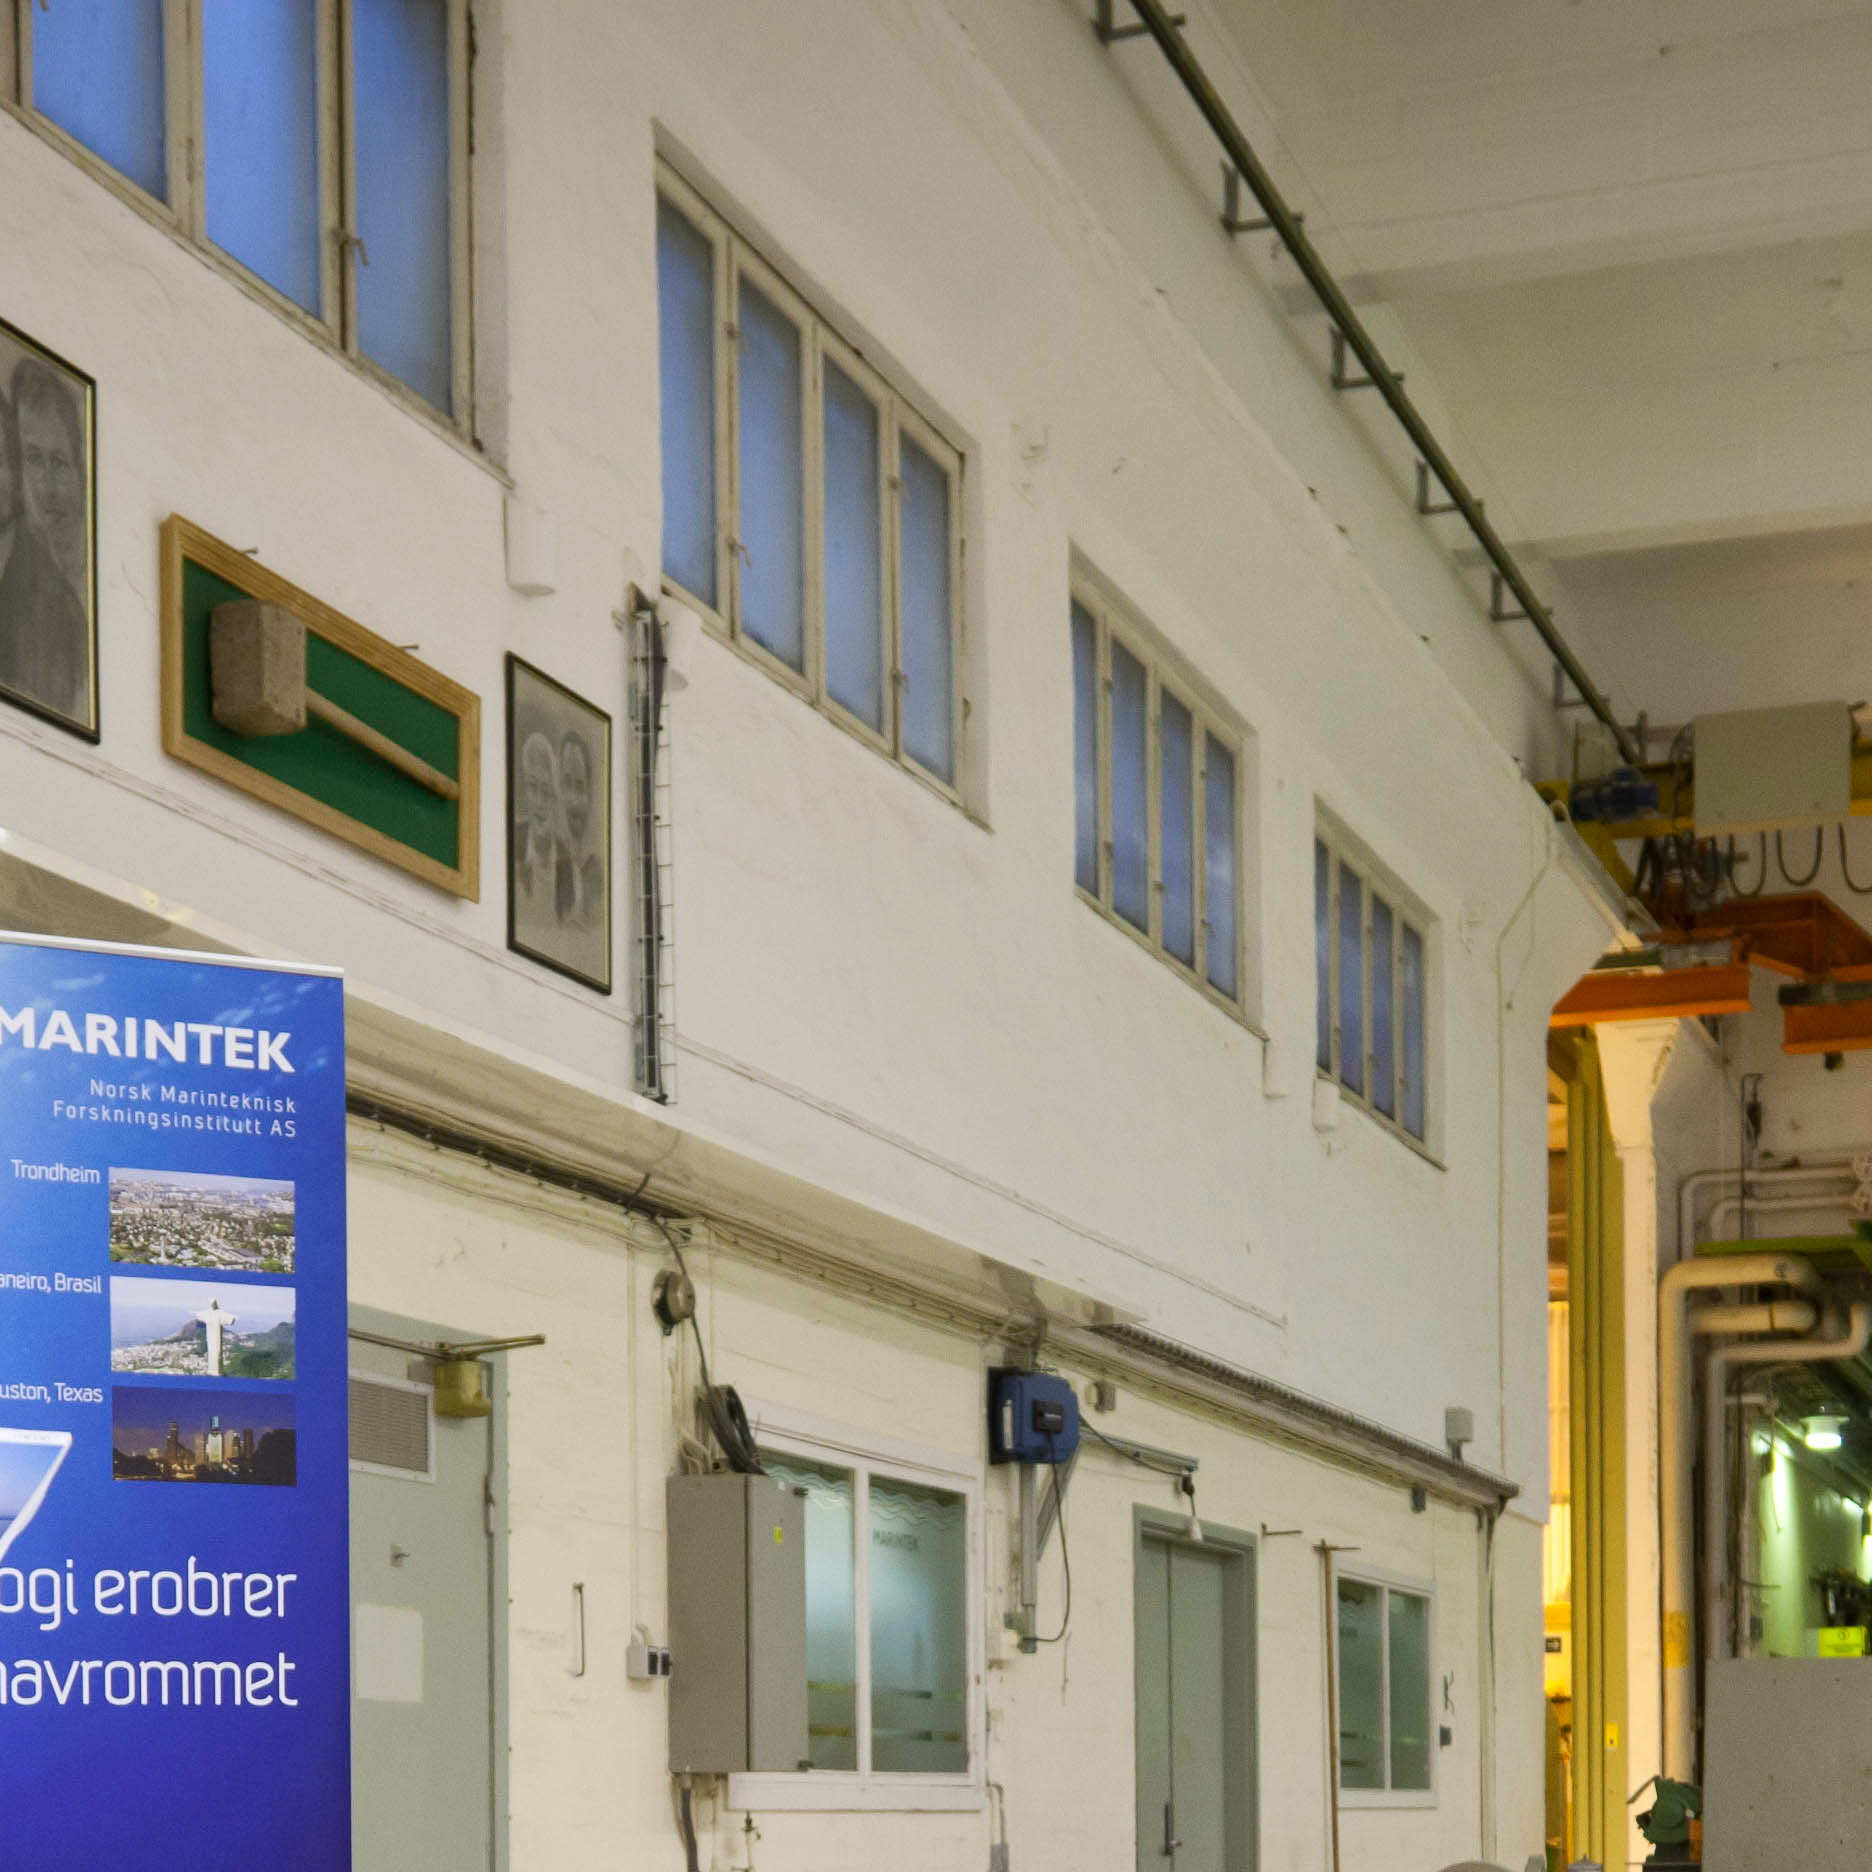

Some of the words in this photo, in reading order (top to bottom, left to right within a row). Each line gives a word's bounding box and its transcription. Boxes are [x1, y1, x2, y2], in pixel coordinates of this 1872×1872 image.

[91, 1079, 152, 1102] Norsk
[160, 1084, 297, 1114] Marinteknisk
[53, 1099, 263, 1137] Forskningsinstitutt
[271, 1119, 297, 1138] AS
[11, 1159, 101, 1184] Trondheim
[55, 1270, 102, 1295] Brasil
[54, 1380, 103, 1404] Texas
[94, 1556, 298, 1618] erobrer
